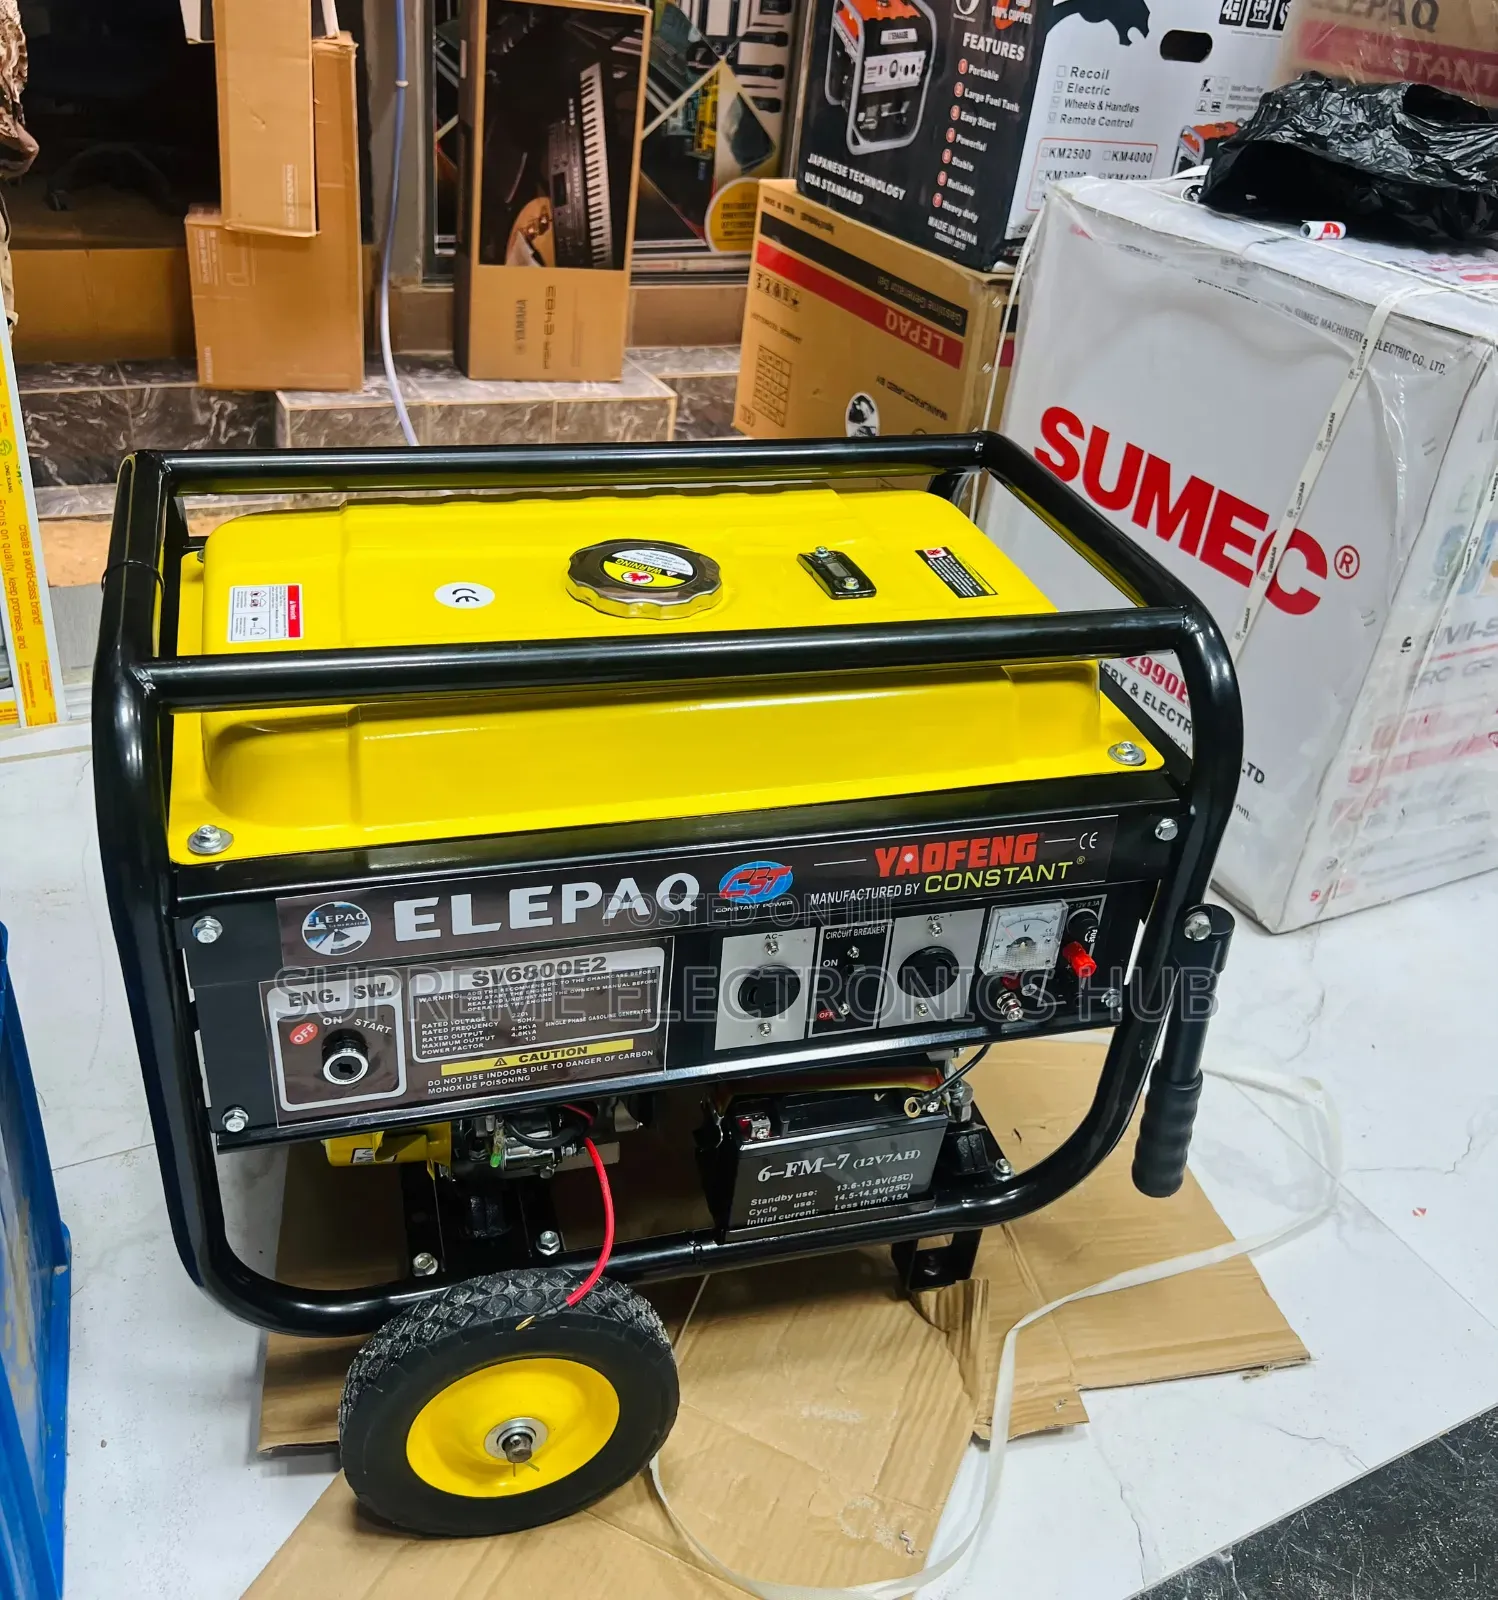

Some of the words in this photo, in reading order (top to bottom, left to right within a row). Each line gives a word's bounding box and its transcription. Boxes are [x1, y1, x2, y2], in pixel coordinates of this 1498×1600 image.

[1009, 9, 1033, 25] COPPER
[963, 31, 1025, 62] FEATURES
[968, 63, 1000, 82] Portable
[1070, 66, 1110, 80] Recoil
[1066, 83, 1111, 96] Electric
[964, 87, 985, 103] Large
[985, 92, 1001, 106] Fuel
[1002, 98, 1020, 113] Tank
[1064, 98, 1096, 110] Wheels
[1096, 101, 1104, 111] &
[1104, 102, 1140, 113] Handles
[960, 111, 978, 127] Easy
[977, 117, 997, 131] Start
[1060, 114, 1096, 126] Remote
[1098, 116, 1134, 128] Control
[956, 133, 988, 152] Powerful
[951, 156, 975, 172] Stable
[1049, 148, 1092, 160] KM2500
[1111, 151, 1153, 163] KM4000
[807, 153, 849, 178] JAPANESE
[847, 168, 907, 201] TECHNOLOGY
[804, 171, 821, 188] USA
[820, 178, 864, 205] STANDARD
[947, 178, 976, 197] Reliable
[941, 200, 963, 217] Heavy
[962, 208, 979, 224] duty
[928, 216, 950, 232] MADE
[947, 225, 957, 237] IN
[955, 227, 978, 246] CHINA
[515, 298, 529, 342] YAMAHA
[886, 308, 945, 356] LEPAQ
[1320, 318, 1365, 344] MACHINERY
[1034, 405, 1328, 616] SUMEC
[1, 529, 8, 540] on
[18, 524, 28, 548] create
[25, 557, 37, 602] world-class
[615, 558, 662, 575] WARNING
[8, 577, 17, 597] keep
[10, 595, 22, 634] promises,
[16, 634, 26, 650] and
[1130, 682, 1139, 699] &
[874, 833, 1039, 878] YAOFENG
[810, 883, 902, 905] MANUFACTURED
[903, 883, 920, 896] BY
[924, 860, 1073, 894] CONSTANT
[394, 872, 700, 942] ELEPAQ
[715, 904, 760, 913] CONSTANT
[762, 900, 793, 908] POWER
[825, 928, 852, 940] CIRCUIT
[853, 925, 886, 937] BREAKER
[1023, 924, 1030, 932] V
[1087, 929, 1098, 943] FUSE
[472, 956, 607, 987] SV6800E2
[822, 959, 839, 968] ON
[630, 969, 656, 977] BEFORE
[288, 989, 341, 1008] ENG.
[353, 982, 393, 1000] SW.
[506, 992, 552, 1003] UNDERSTAND
[632, 978, 658, 986] BEFORE
[529, 987, 552, 995] ENGINE
[467, 1003, 508, 1012] OPERATING
[529, 997, 552, 1005] ENGINE
[568, 1016, 587, 1024] PHASE
[588, 1012, 617, 1021] GASOLINE
[618, 1008, 652, 1017] GENERATOR
[818, 1010, 834, 1019] OFF
[293, 1023, 315, 1043] OFF
[322, 1016, 343, 1026] ON
[354, 1018, 393, 1035] START
[421, 1021, 448, 1029] RATED
[422, 1027, 449, 1036] RATED
[451, 1021, 499, 1032] FREQUENCY
[421, 1040, 461, 1050] MAXIMUM
[463, 1035, 496, 1044] OUTPUT
[422, 1034, 449, 1043] RATED
[451, 1030, 484, 1039] OUTPUT
[421, 1047, 450, 1056] POWER
[452, 1043, 485, 1052] FACTOR
[518, 1046, 588, 1063] CAUTION
[428, 1079, 441, 1087] DO
[444, 1076, 463, 1085] NOT
[465, 1073, 484, 1081] USE
[487, 1067, 528, 1079] INDOORS
[530, 1064, 549, 1073] DUE
[566, 1057, 602, 1068] DANGER
[618, 1050, 654, 1060] CARBON
[428, 1082, 477, 1094] MONOXIDE
[480, 1074, 531, 1087] POISONING
[852, 1150, 921, 1169] (12V7AH)
[751, 1193, 793, 1206] Standby
[795, 1190, 818, 1200] use:
[747, 1214, 777, 1226] Initial
[778, 1208, 819, 1221] current:
[834, 1201, 859, 1211] Less
[749, 1205, 778, 1217] Cycle
[793, 1199, 815, 1209] use:
